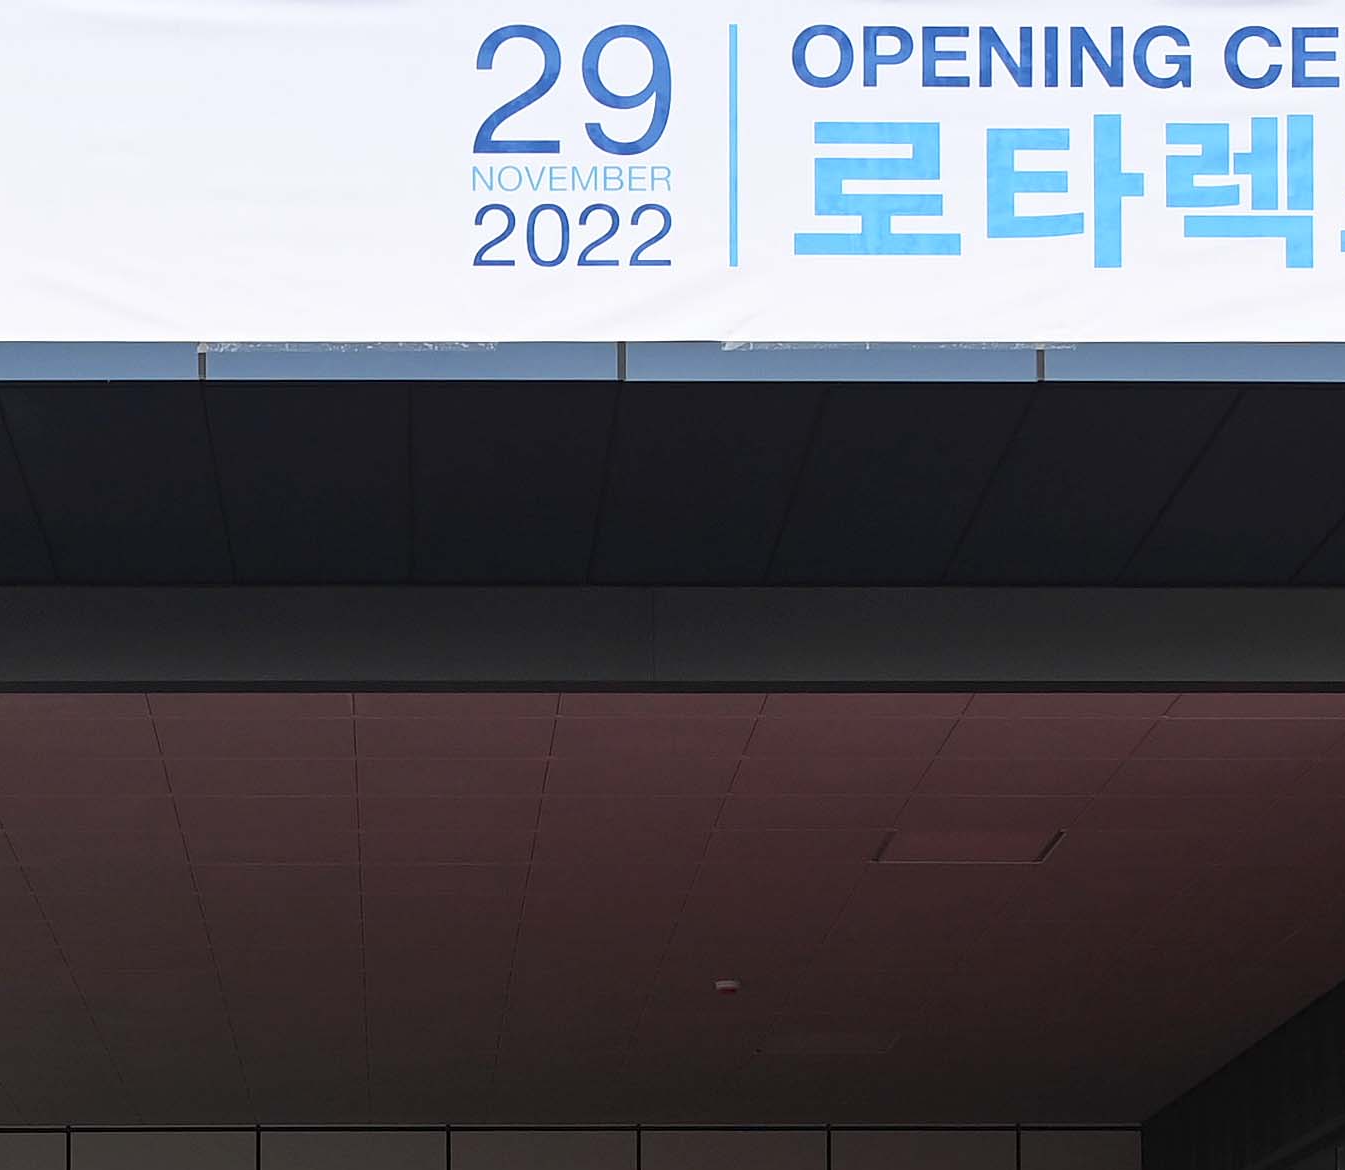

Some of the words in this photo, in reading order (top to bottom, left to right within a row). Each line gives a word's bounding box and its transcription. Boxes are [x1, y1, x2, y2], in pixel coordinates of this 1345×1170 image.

[792, 25, 1192, 90] OPENING
[473, 24, 672, 156] 29
[471, 166, 671, 193] NOVEMBER
[474, 203, 672, 267] 2022
